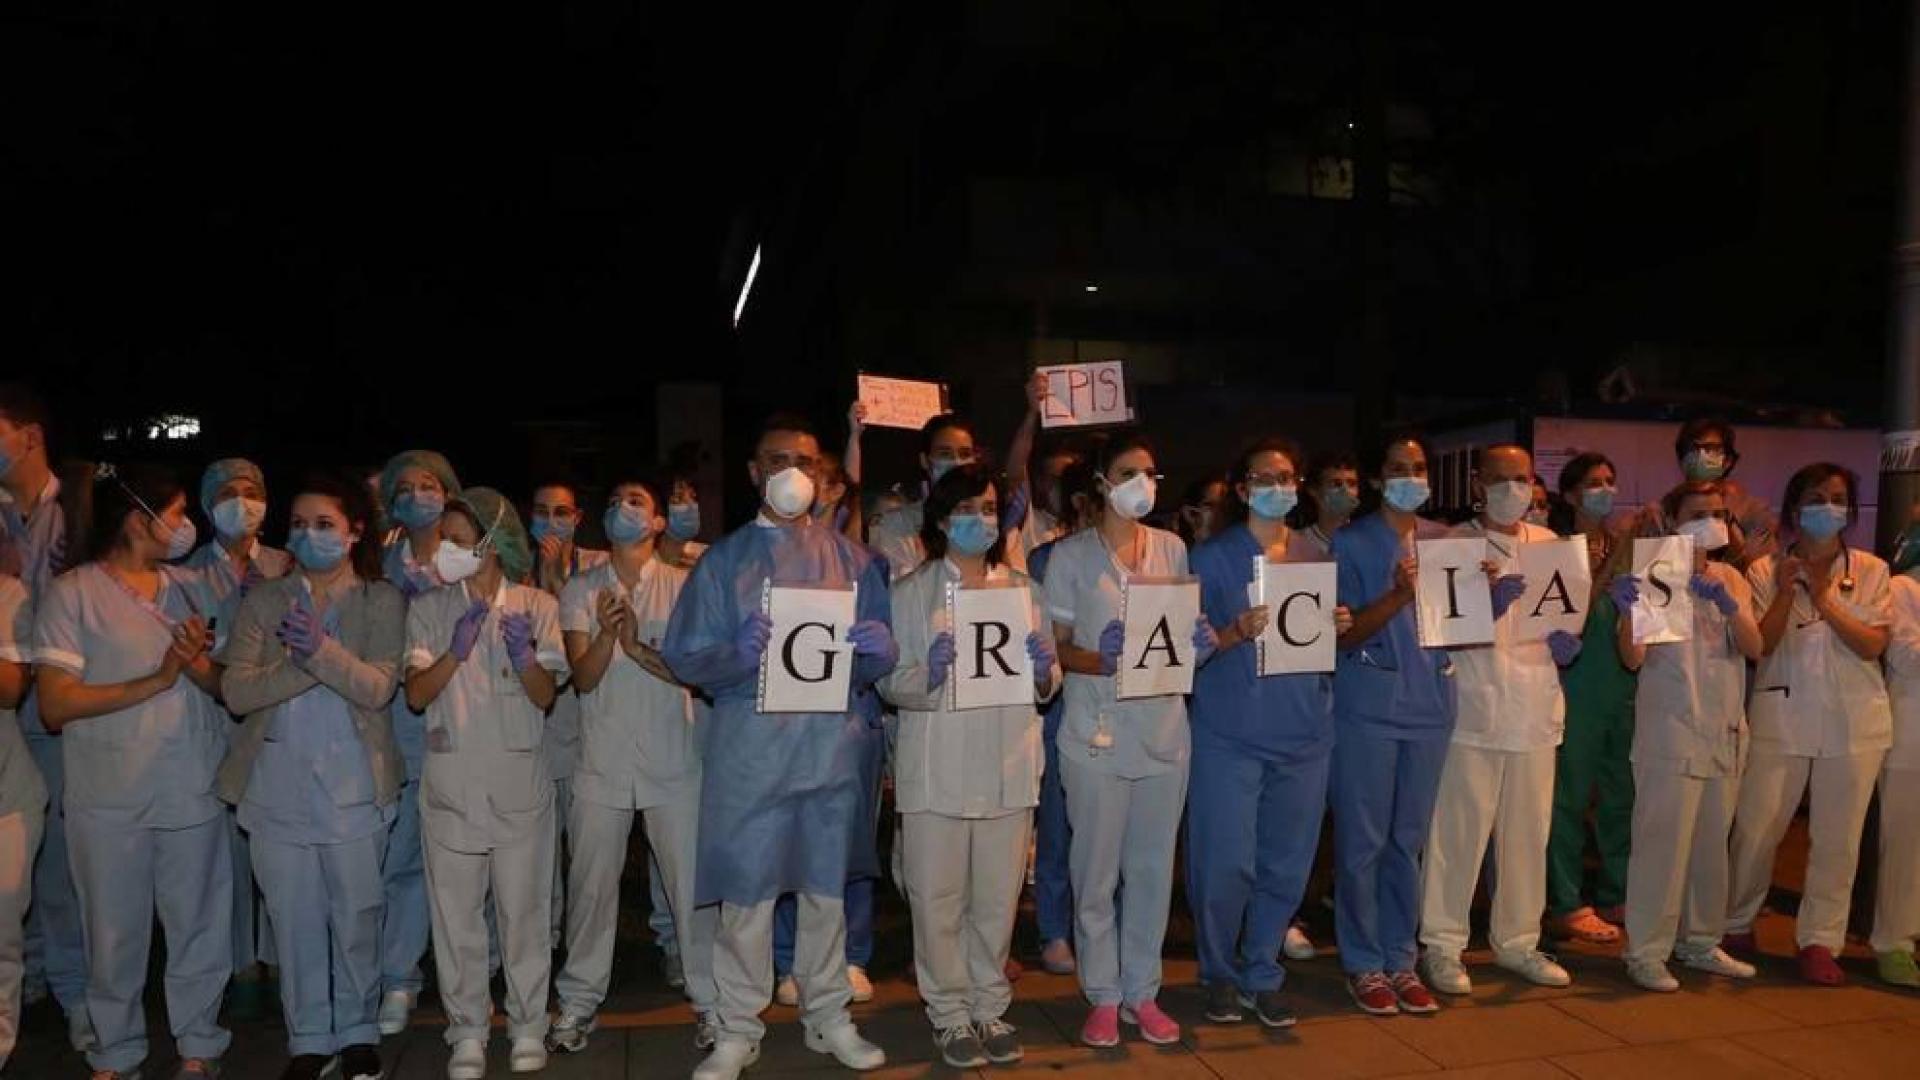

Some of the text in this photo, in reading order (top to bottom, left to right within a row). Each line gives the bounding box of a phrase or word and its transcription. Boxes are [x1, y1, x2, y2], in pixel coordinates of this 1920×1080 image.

[1044, 368, 1118, 420] EPIS
[1442, 567, 1464, 619] I
[1529, 569, 1580, 618] A
[1647, 560, 1673, 608] S
[1132, 614, 1183, 670] A
[1277, 591, 1321, 647] C
[781, 621, 839, 683] G
[969, 621, 1021, 679] R
